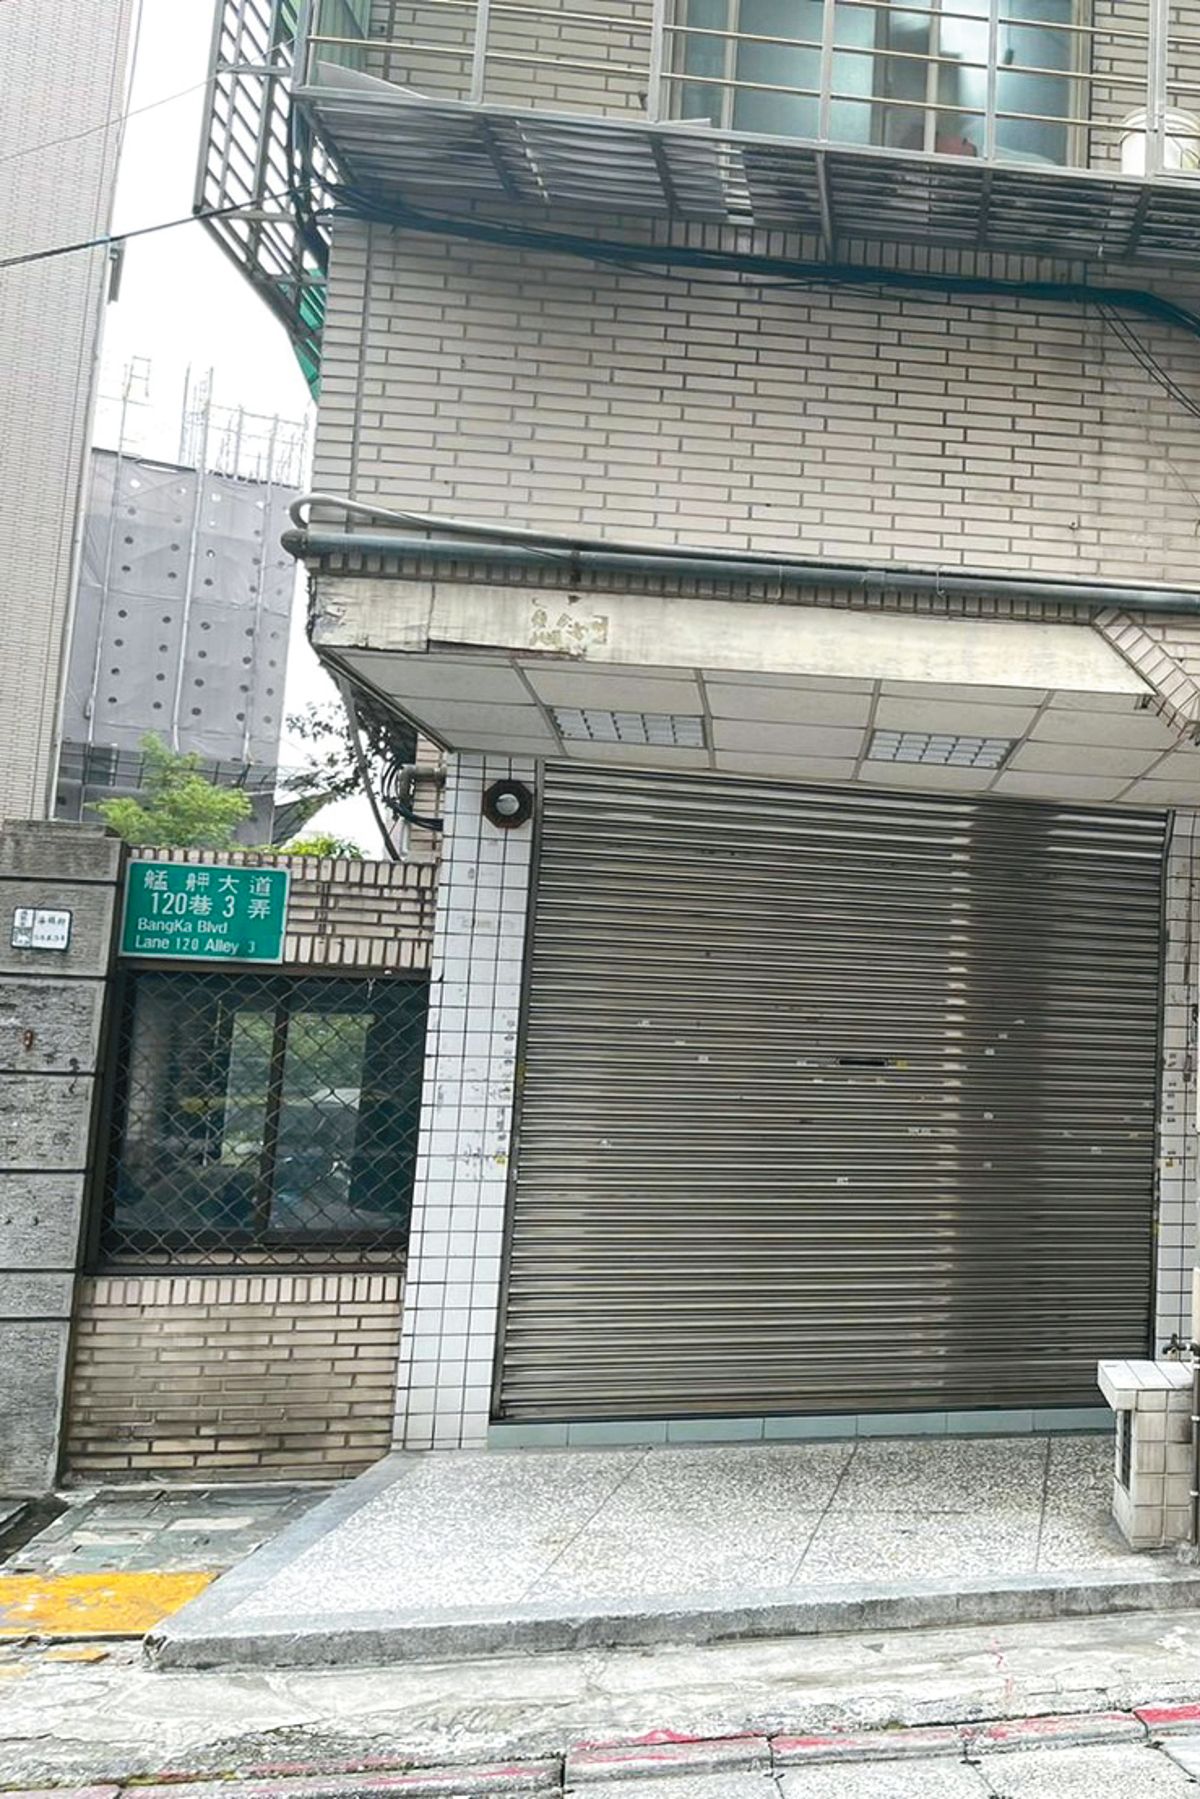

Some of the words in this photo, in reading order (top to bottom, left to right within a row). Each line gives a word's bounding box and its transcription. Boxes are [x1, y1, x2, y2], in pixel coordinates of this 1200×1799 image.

[144, 869, 273, 897] 艋舺大道
[138, 917, 192, 934] BangKa
[197, 919, 228, 934] Blvd
[135, 935, 170, 949] Lane
[176, 937, 199, 951] 120
[204, 938, 239, 955] Alley
[247, 941, 256, 954] 3
